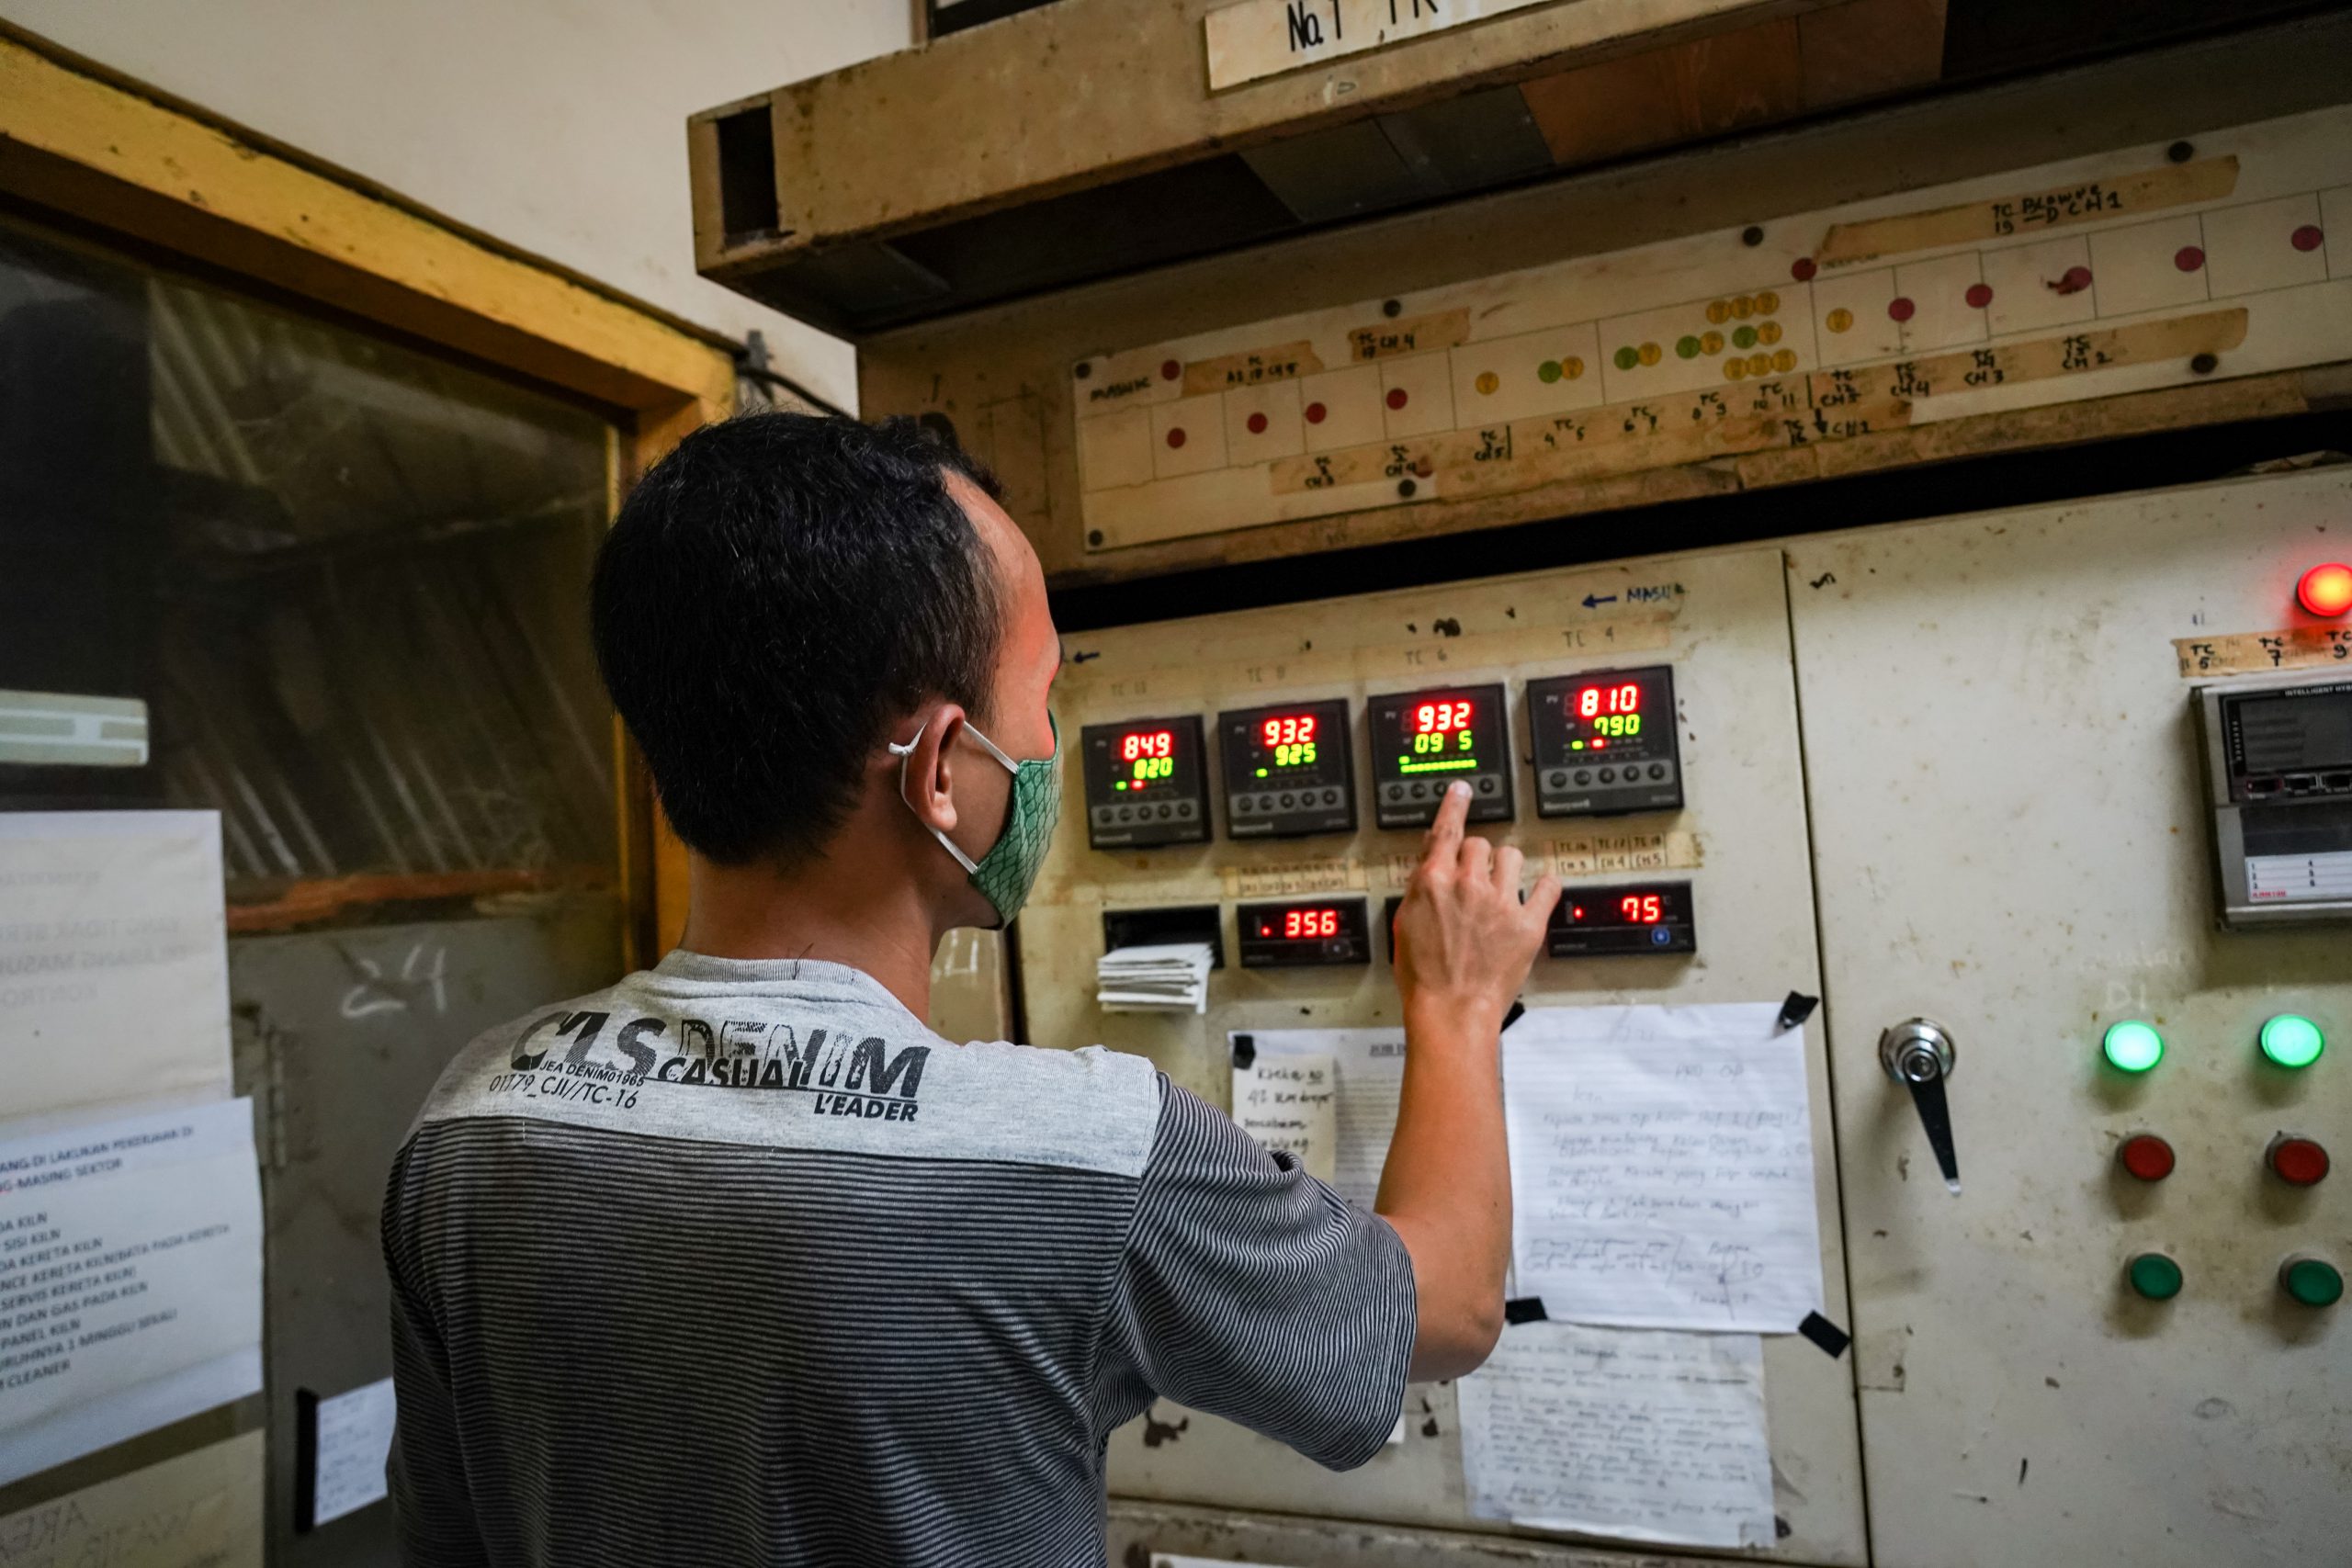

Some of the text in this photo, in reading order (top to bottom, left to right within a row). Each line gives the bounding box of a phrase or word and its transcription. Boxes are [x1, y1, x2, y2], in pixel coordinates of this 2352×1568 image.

[1699, 392, 1719, 405] TC
[1759, 382, 1782, 397] TC
[1632, 407, 1650, 417] TC
[1554, 419, 1574, 430] TC
[1580, 685, 1637, 716] 810
[1418, 701, 1471, 732] 932
[1594, 714, 1641, 736] 790
[1264, 716, 1316, 746] 932
[1124, 731, 1172, 761] 849
[1275, 742, 1317, 766] 925
[1623, 896, 1660, 923] 75
[1285, 908, 1338, 938] 356
[658, 1056, 809, 1088] CASUAL
[17, 1211, 48, 1229] KILN
[30, 1228, 61, 1245] KILN
[19, 1245, 70, 1267] KERETA
[32, 1261, 82, 1285] KERETA
